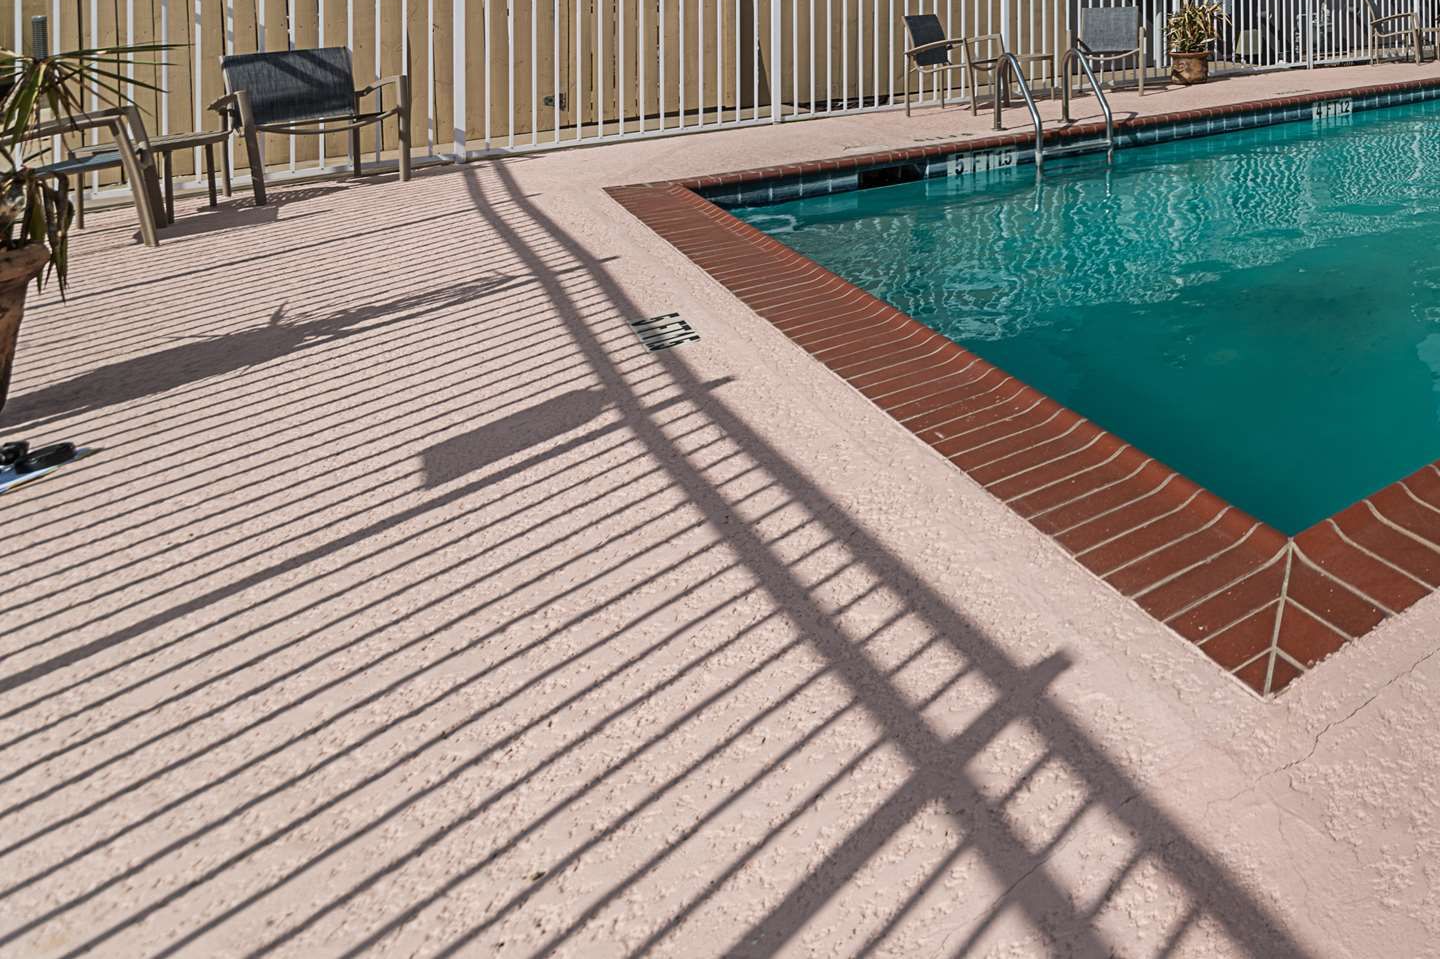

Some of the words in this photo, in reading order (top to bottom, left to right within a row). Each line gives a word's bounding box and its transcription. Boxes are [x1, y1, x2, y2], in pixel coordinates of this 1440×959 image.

[1316, 101, 1322, 118] 4
[955, 153, 964, 175] 5
[973, 150, 994, 173] FT
